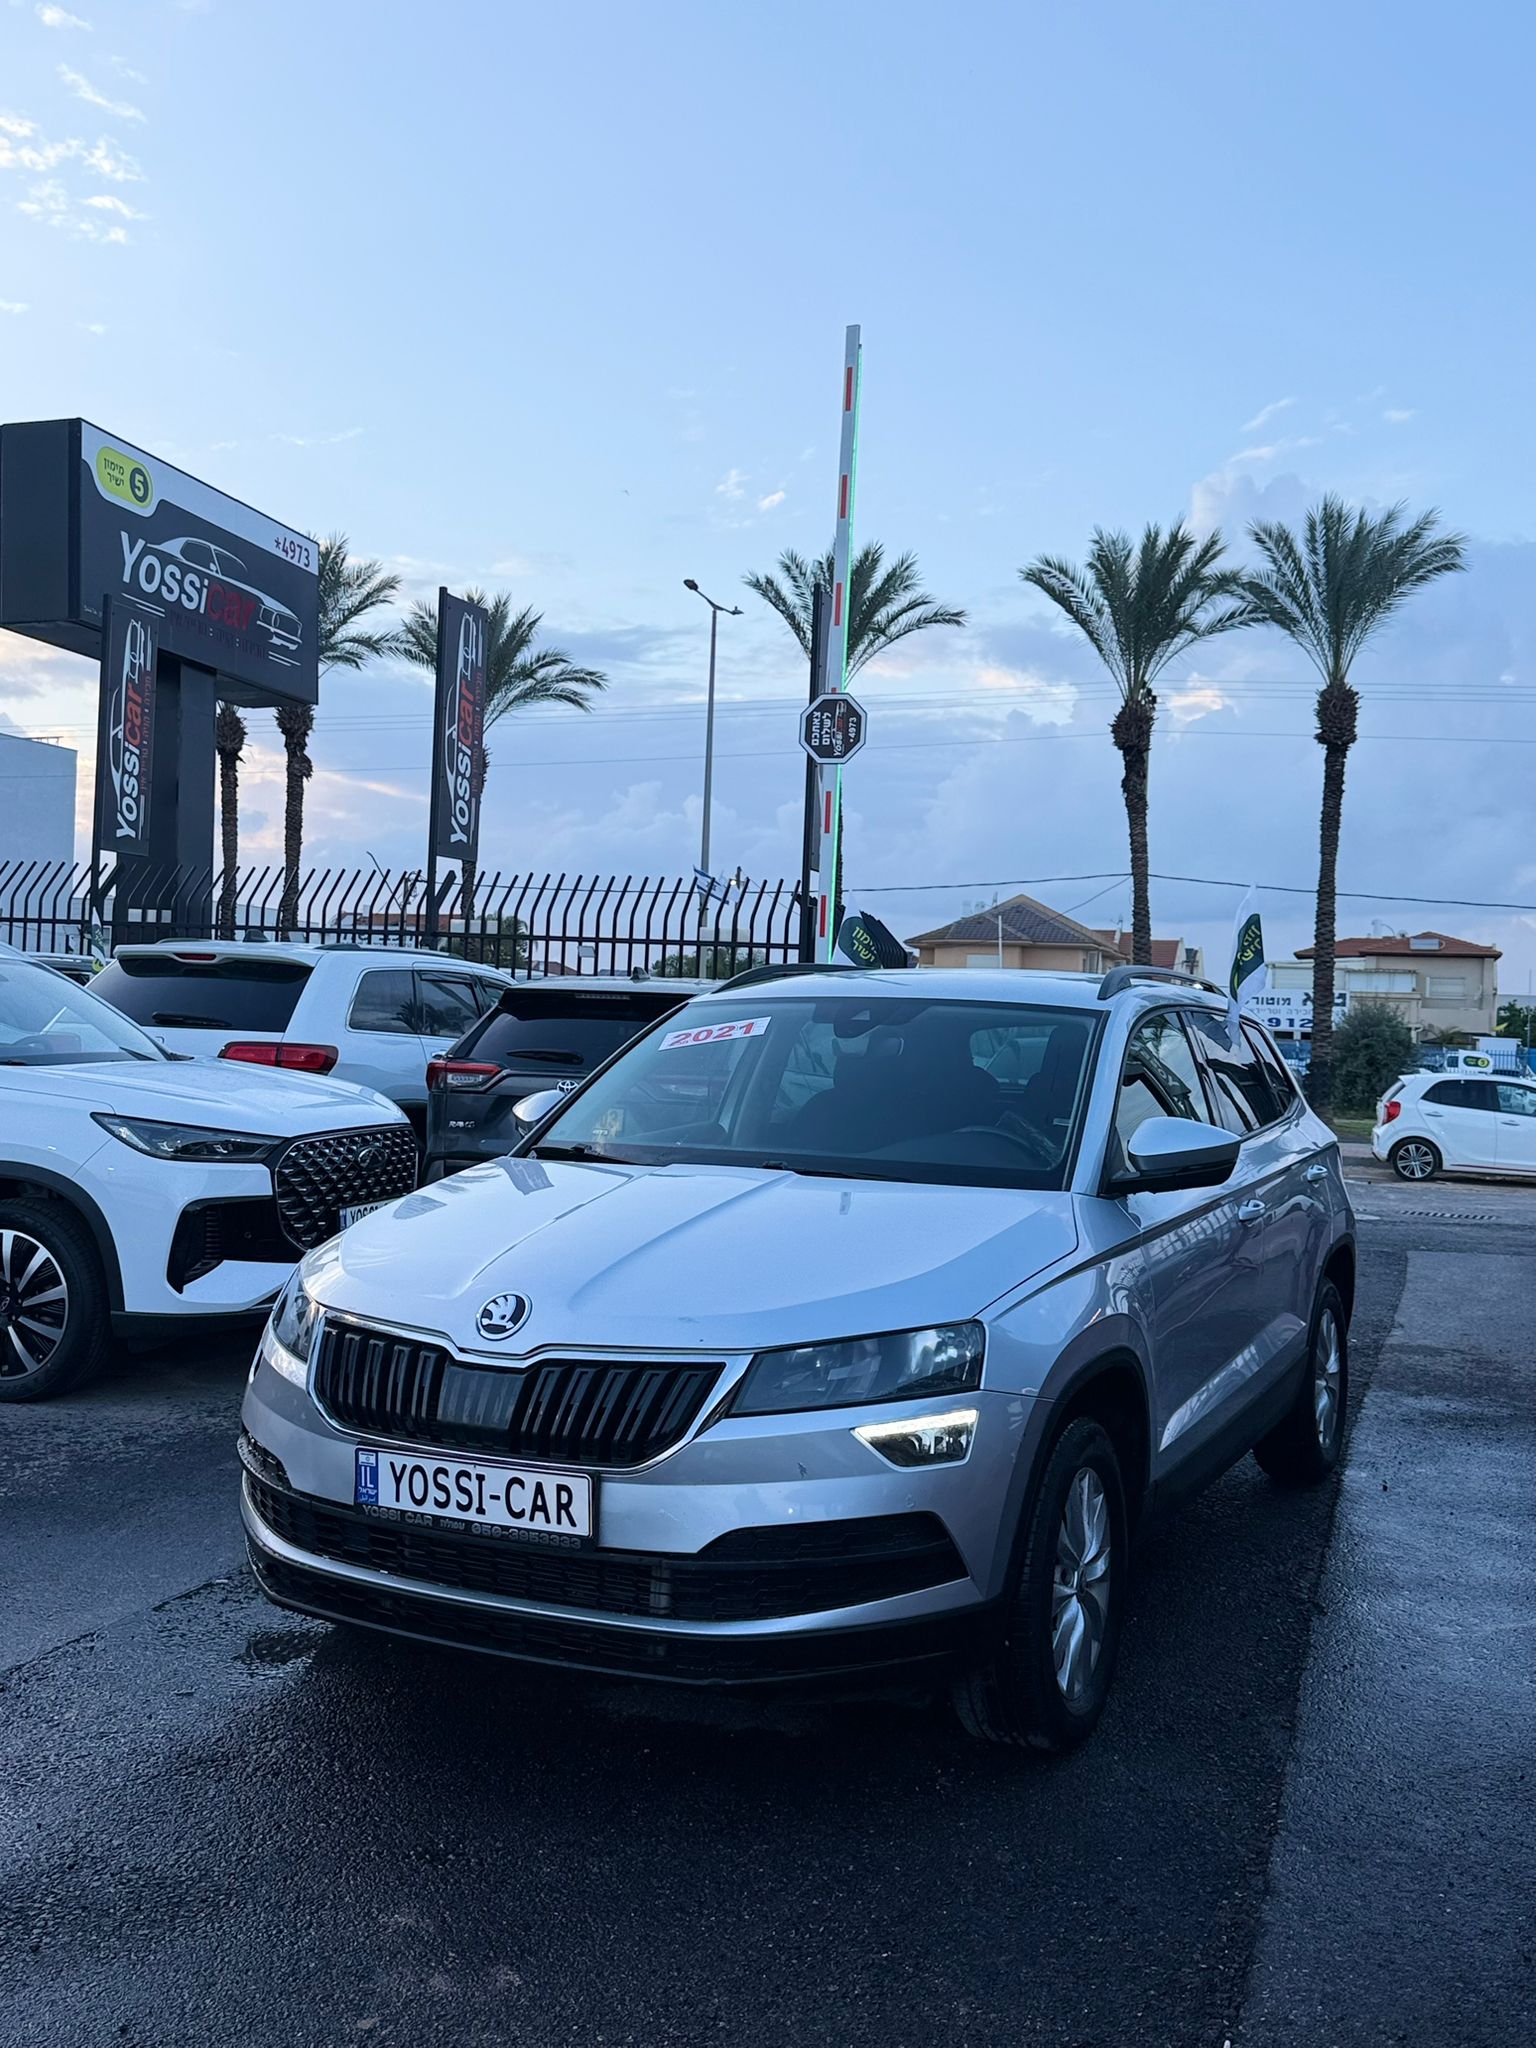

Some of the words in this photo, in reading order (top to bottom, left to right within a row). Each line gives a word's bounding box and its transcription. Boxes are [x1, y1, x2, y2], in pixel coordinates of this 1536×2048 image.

[103, 457, 125, 476] מימון
[107, 472, 125, 487] ישיר
[811, 711, 821, 746] צאתכם
[821, 712, 832, 745] לשלום
[1245, 996, 1292, 1006] מוטור
[669, 1022, 754, 1046] 2021
[361, 1466, 374, 1488] IL
[389, 1461, 577, 1527] YOSSI-CAR
[362, 1505, 400, 1520] YOSSI
[405, 1512, 433, 1527] CAR
